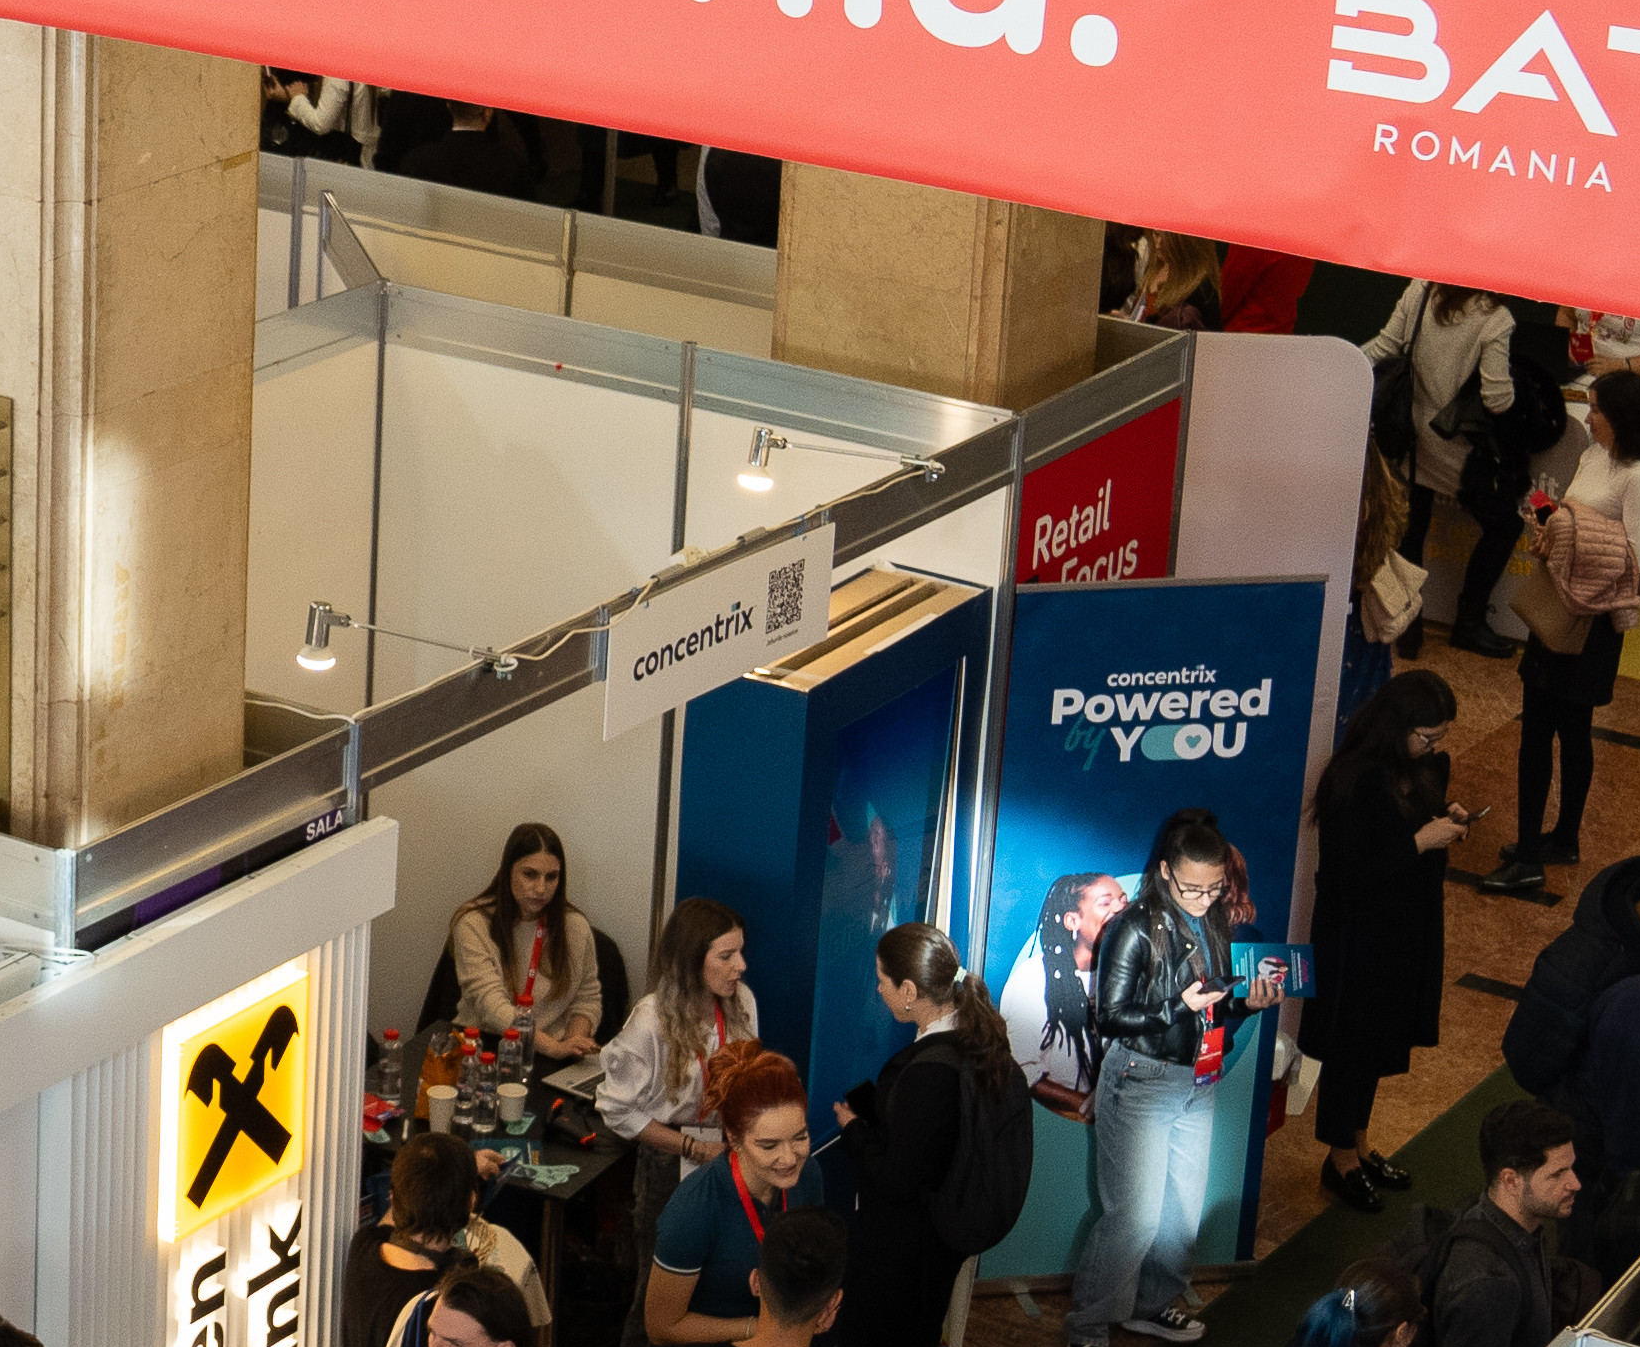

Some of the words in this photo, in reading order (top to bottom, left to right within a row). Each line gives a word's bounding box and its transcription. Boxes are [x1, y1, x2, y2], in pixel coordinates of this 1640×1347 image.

[1373, 123, 1612, 193] ROMANIA
[1031, 478, 1112, 571] Retail
[1061, 538, 1139, 584] Focus
[633, 601, 756, 683] concentrix
[1051, 678, 1273, 725] Powered
[1106, 663, 1217, 688] concentrix
[1064, 714, 1107, 771] by
[1110, 721, 1248, 763] YOU
[306, 809, 344, 842] SALA
